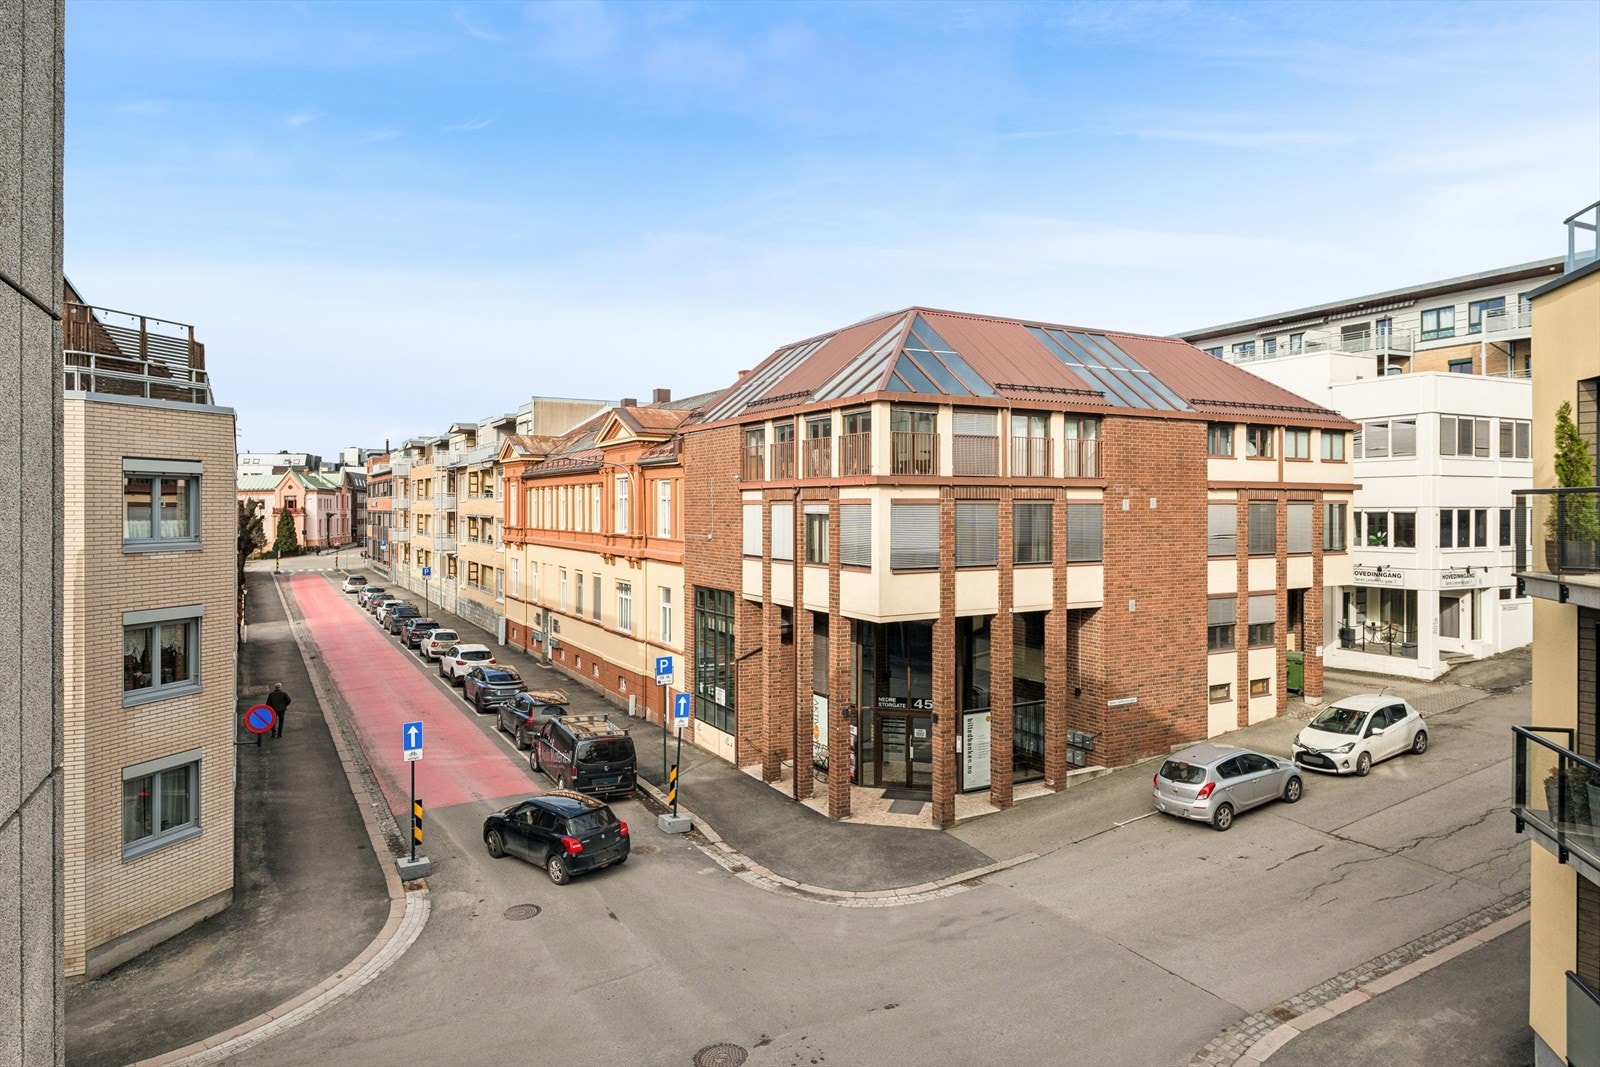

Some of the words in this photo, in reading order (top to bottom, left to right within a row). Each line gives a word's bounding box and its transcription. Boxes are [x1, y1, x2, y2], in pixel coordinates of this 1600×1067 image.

[1354, 570, 1402, 579] OVEDINNGANG
[660, 659, 669, 673] P
[914, 699, 933, 709] 45
